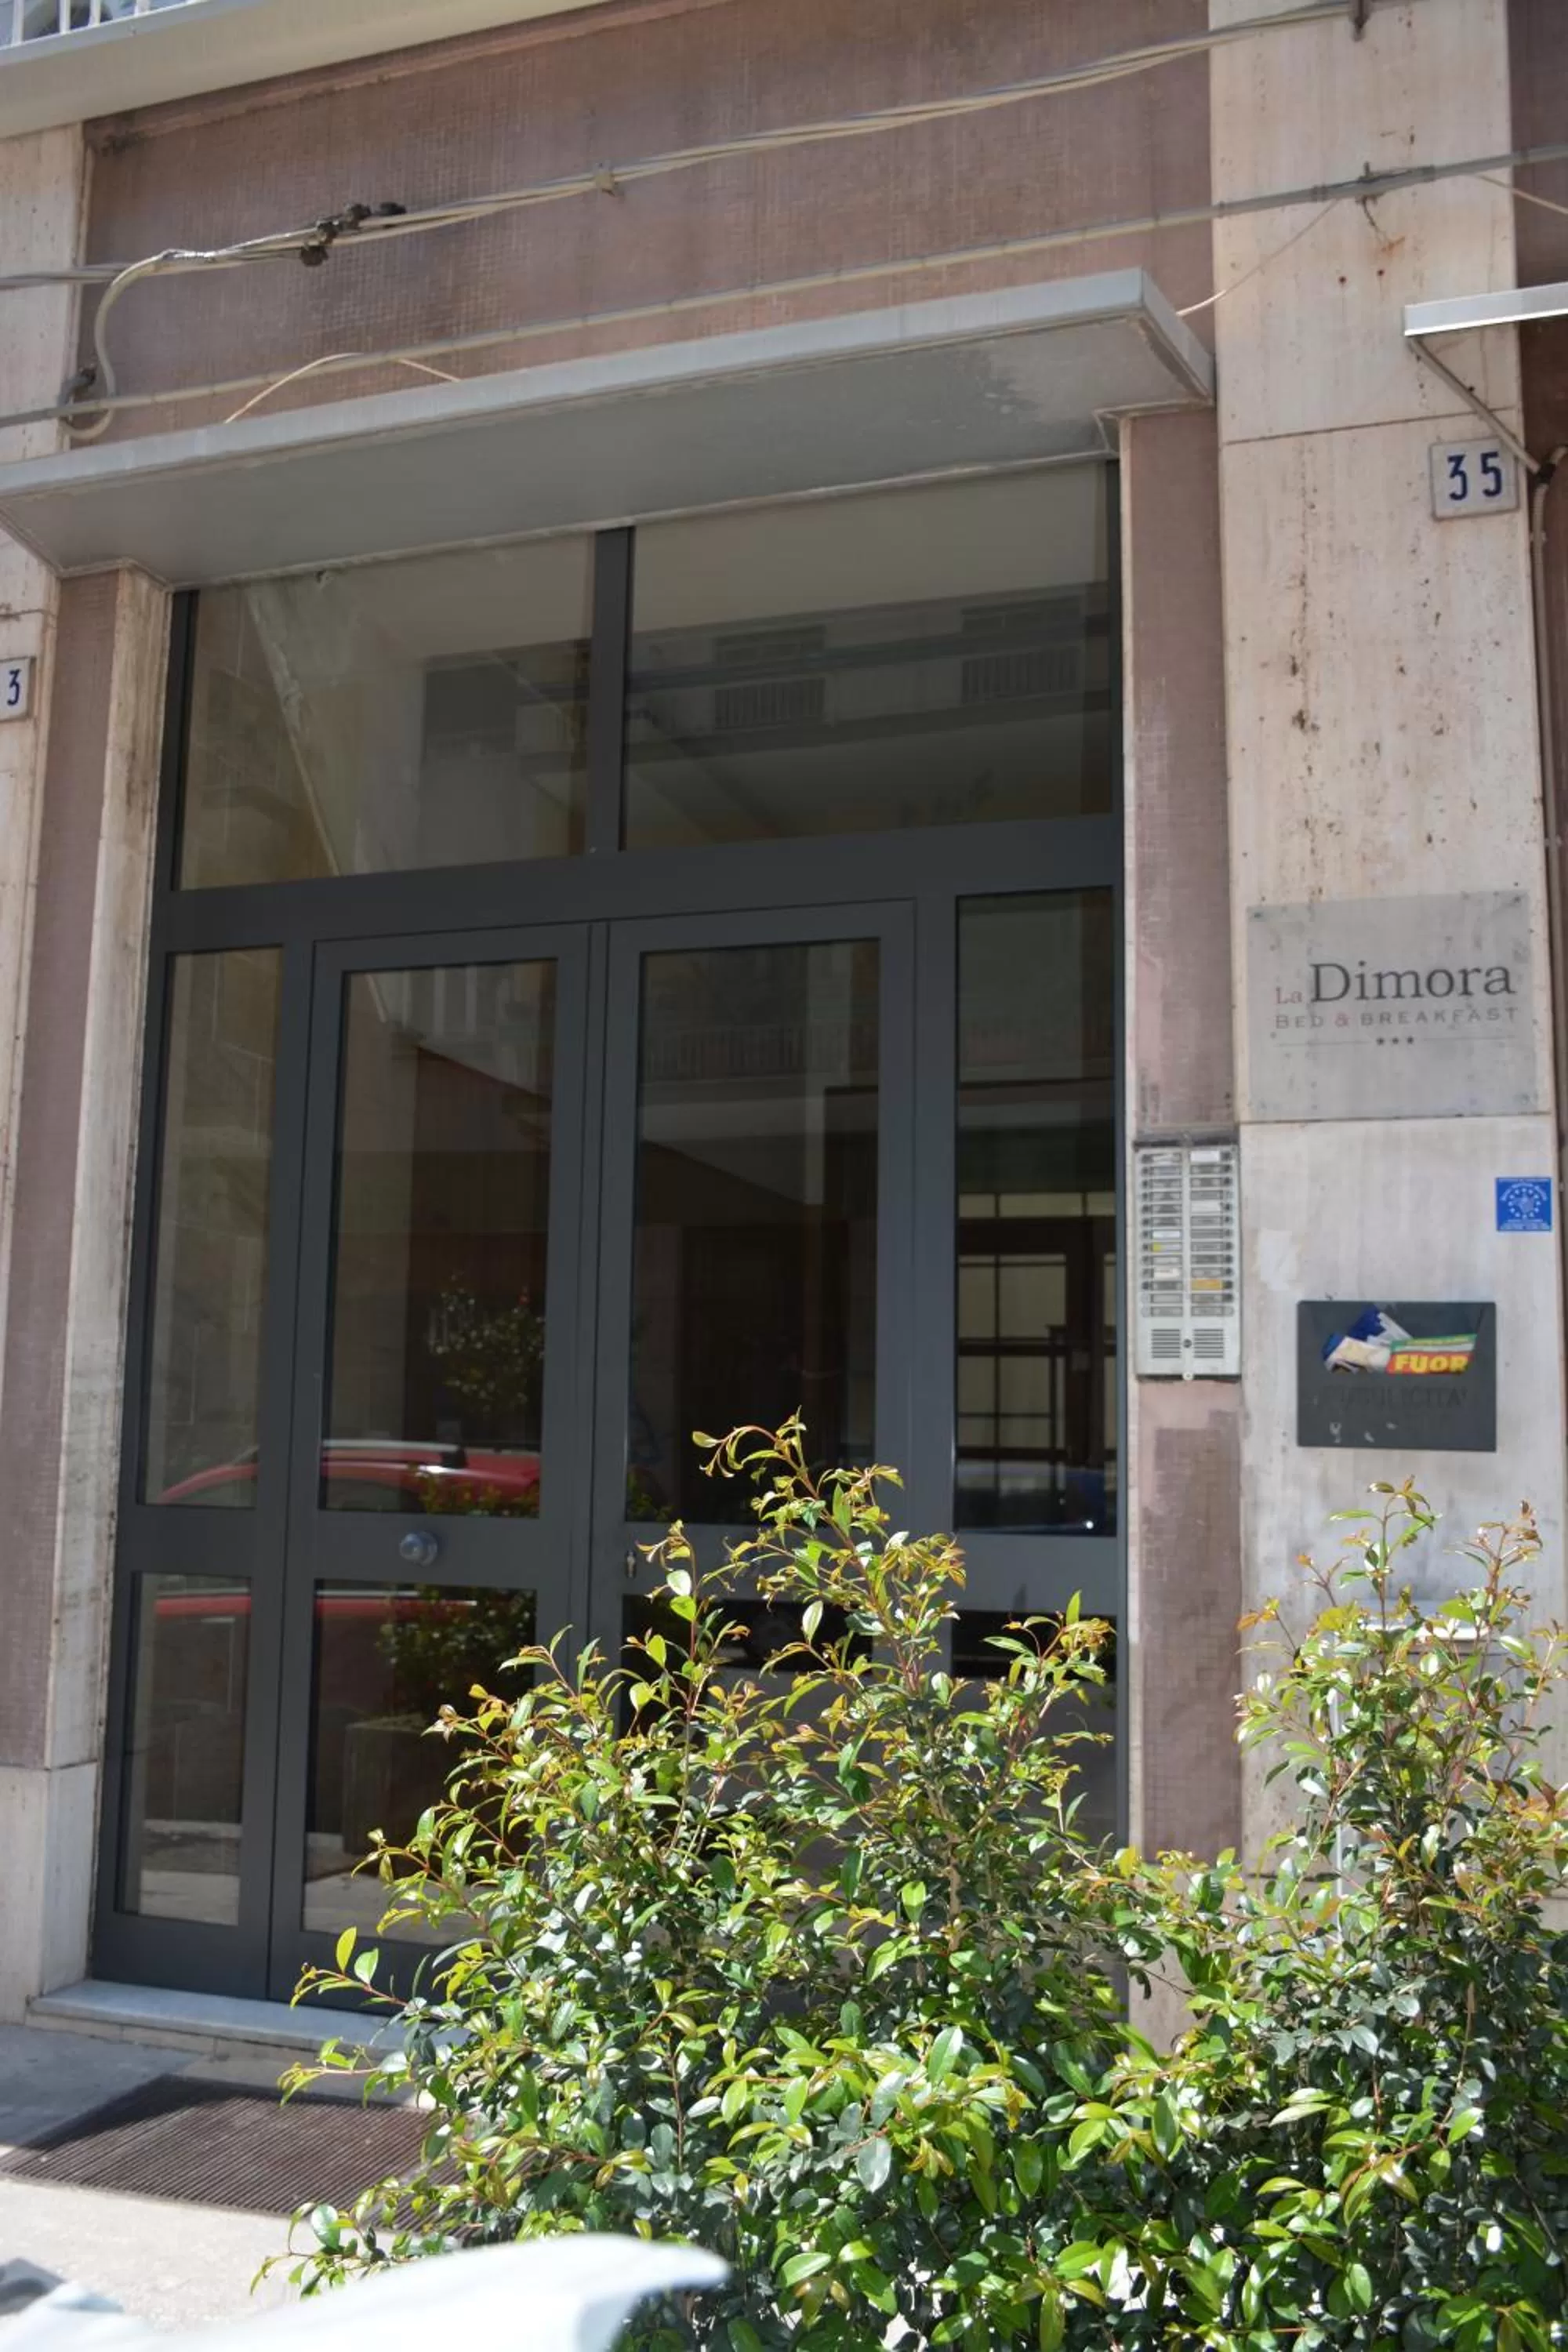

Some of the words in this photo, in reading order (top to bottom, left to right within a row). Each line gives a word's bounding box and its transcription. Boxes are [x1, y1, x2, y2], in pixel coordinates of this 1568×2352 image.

[1446, 450, 1503, 502] 35
[6, 668, 21, 706] 3
[1275, 986, 1303, 1004] La
[1309, 960, 1517, 1003] Dimora
[1275, 1014, 1324, 1029] BED
[1334, 1012, 1350, 1028] &
[1360, 1007, 1519, 1027] BREAKFAST
